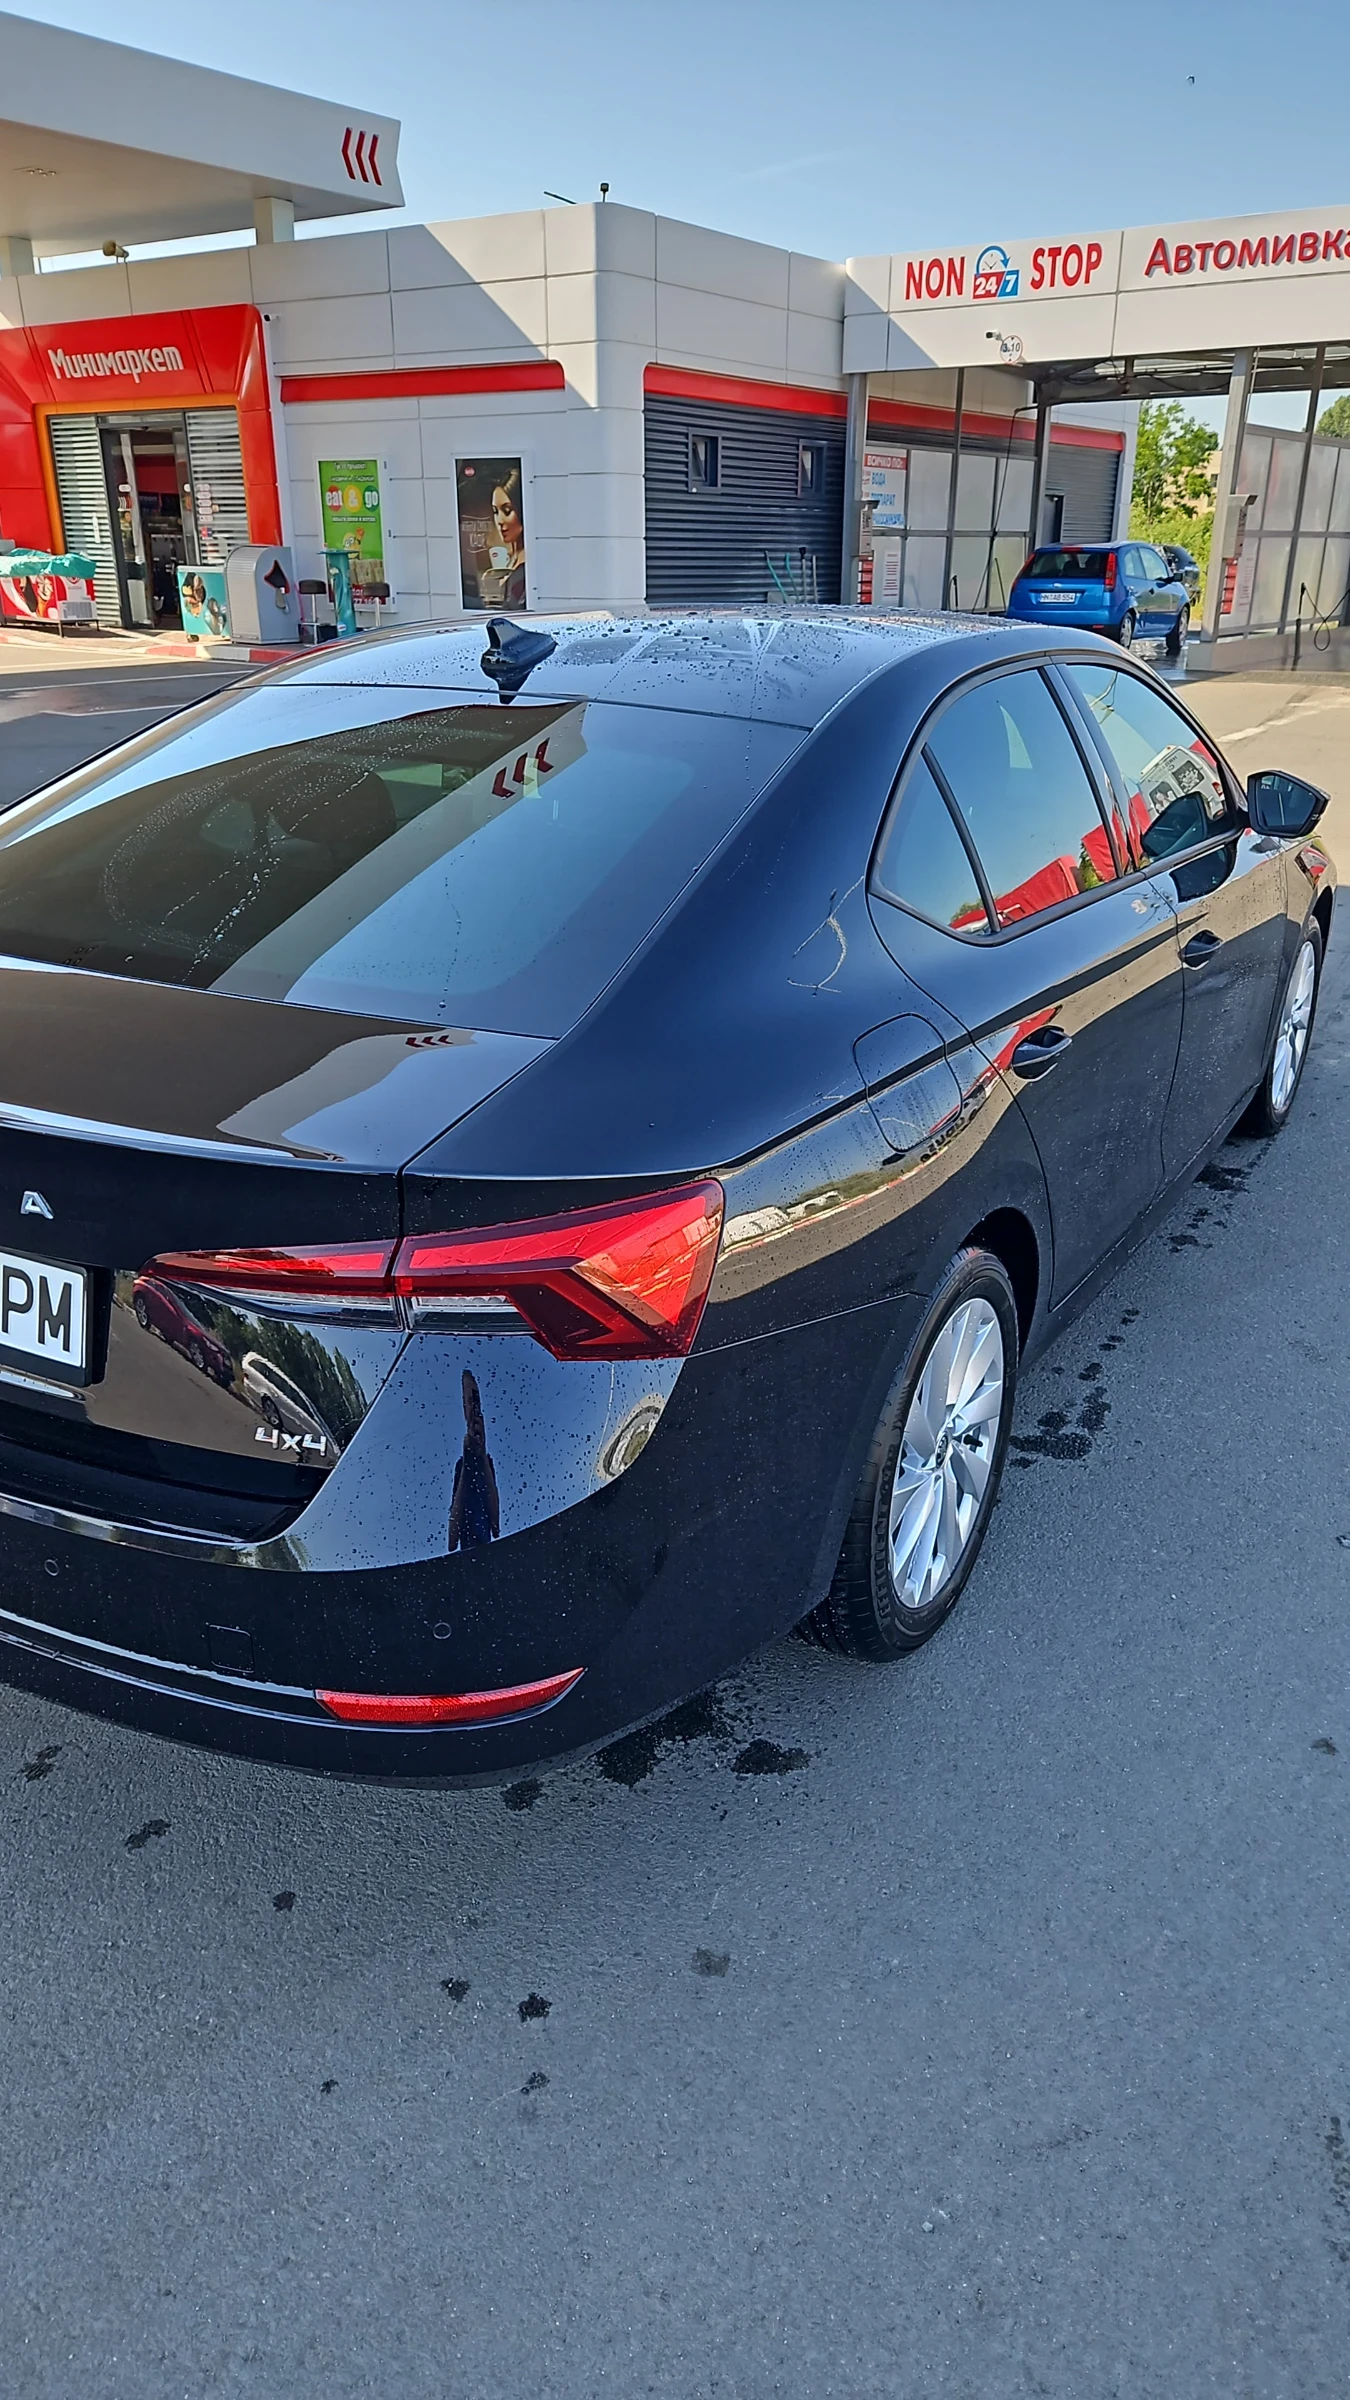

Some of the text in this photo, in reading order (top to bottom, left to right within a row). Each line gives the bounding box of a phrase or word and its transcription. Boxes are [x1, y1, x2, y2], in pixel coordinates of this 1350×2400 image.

[905, 256, 965, 300] NON
[1030, 242, 1103, 290] STOP
[47, 346, 184, 383] Минимаркет
[325, 489, 343, 506] eat
[364, 491, 379, 508] go
[2, 1264, 72, 1352] PM
[255, 1427, 326, 1456] 4x4
